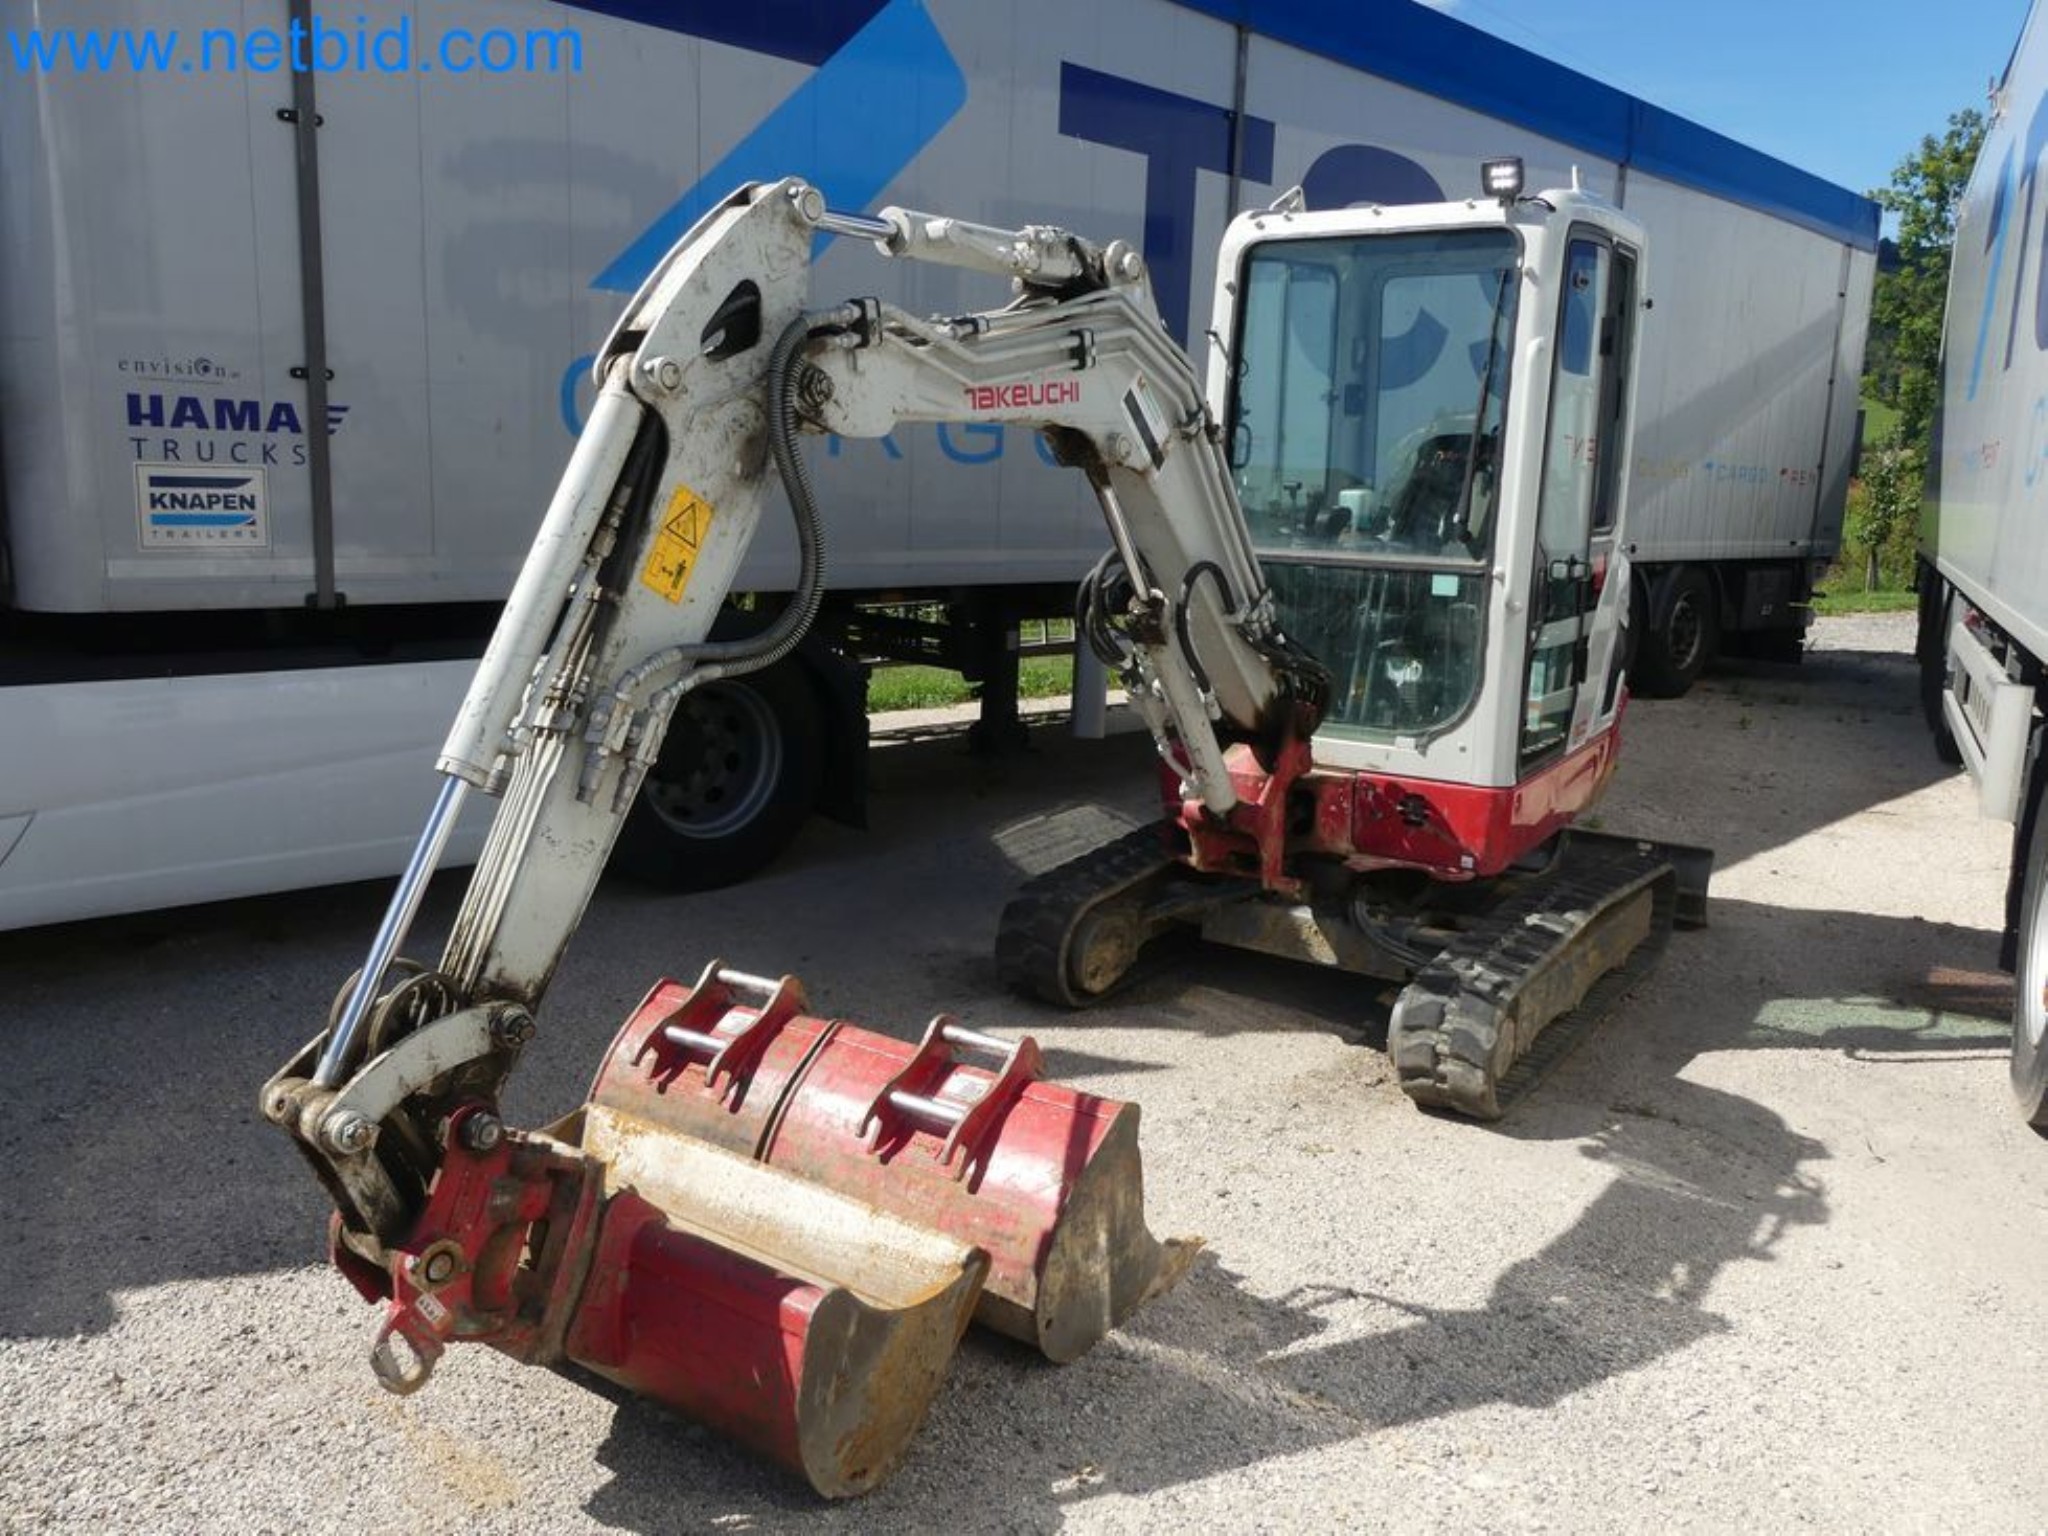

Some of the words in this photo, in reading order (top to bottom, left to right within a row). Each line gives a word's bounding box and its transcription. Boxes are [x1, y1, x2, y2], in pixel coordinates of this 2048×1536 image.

[118, 358, 226, 378] envision
[127, 393, 303, 434] HAMA
[129, 437, 307, 466] TRUCKS
[150, 492, 257, 511] KNAPEN
[151, 529, 258, 539] TRAILERS
